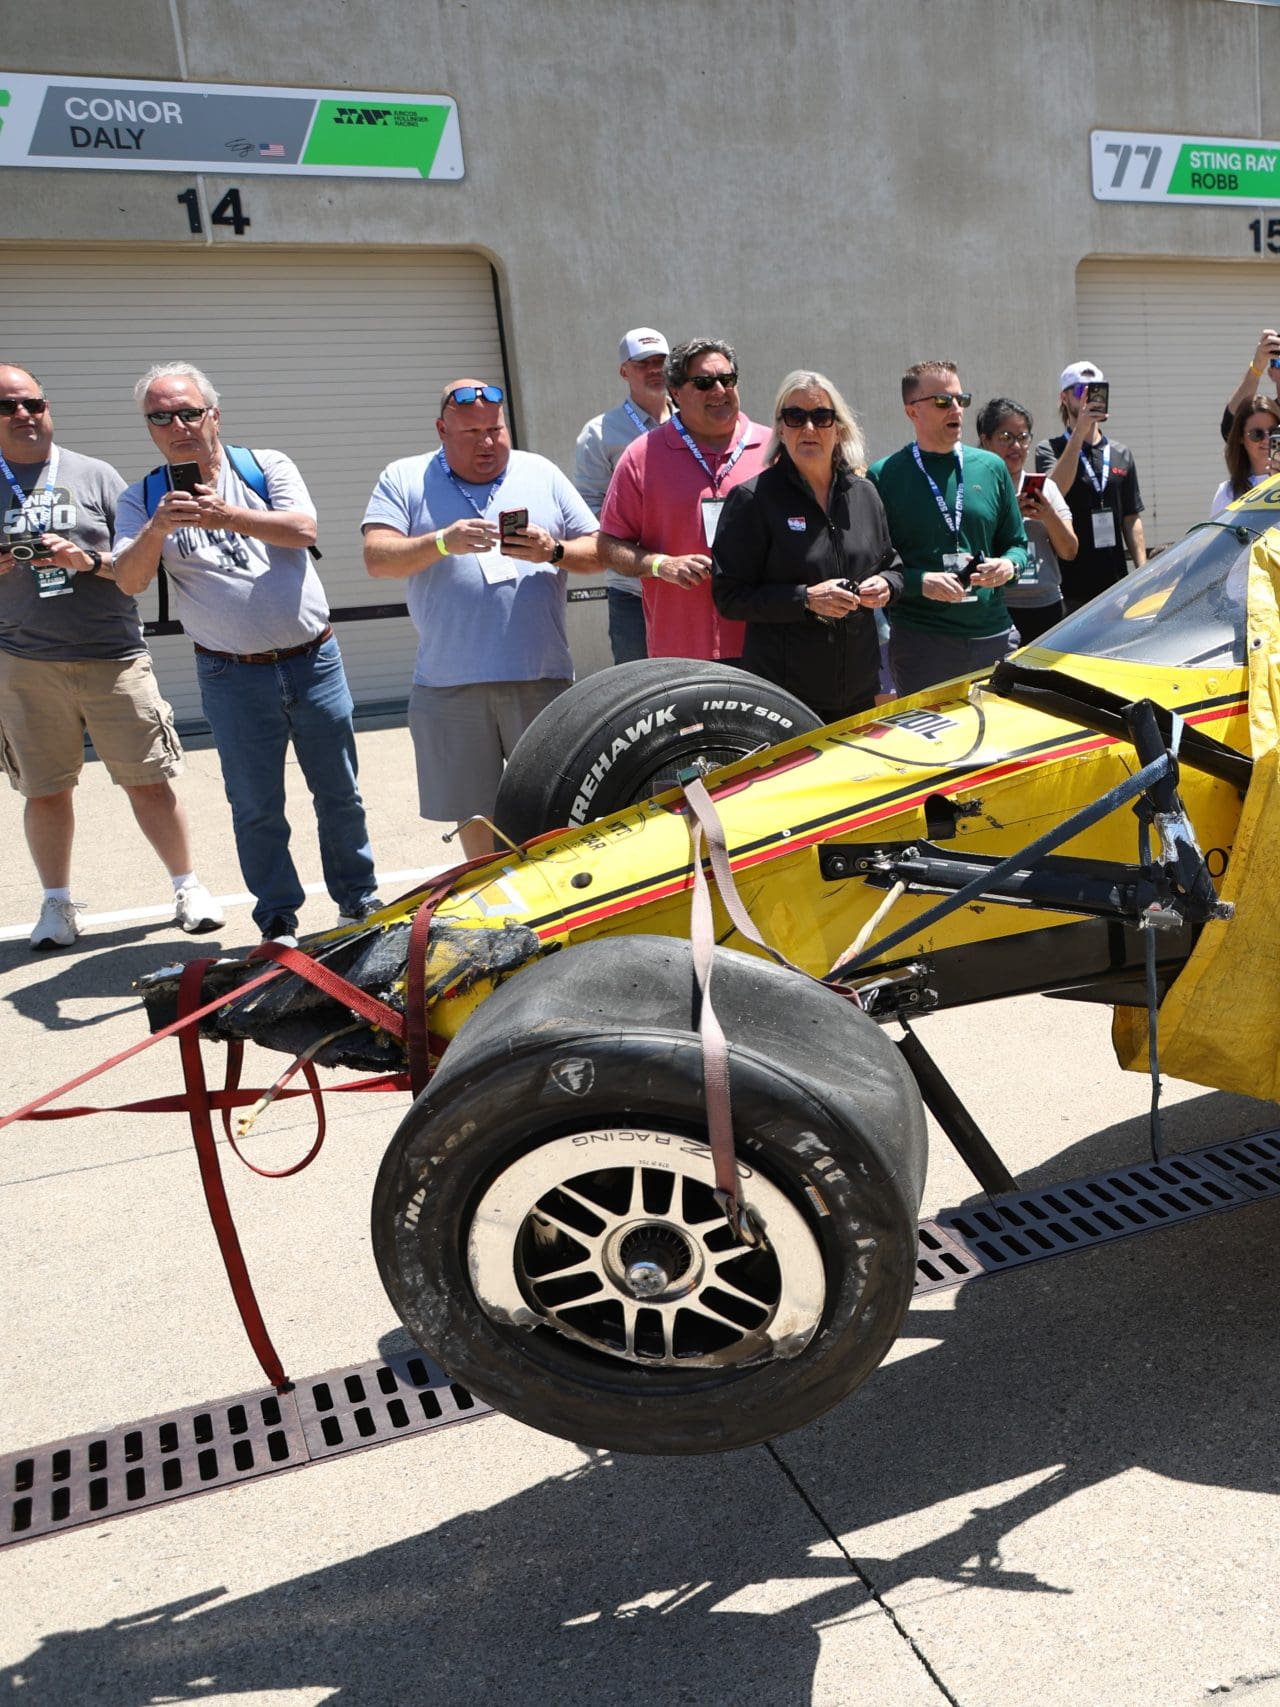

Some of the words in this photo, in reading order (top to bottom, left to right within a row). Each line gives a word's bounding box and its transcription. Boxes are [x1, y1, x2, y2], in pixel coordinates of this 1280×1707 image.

[65, 97, 183, 124] CONOR
[69, 126, 145, 150] DALY
[1104, 144, 1163, 189] 77
[1190, 151, 1243, 171] STING
[1246, 153, 1278, 172] RAY
[1191, 173, 1239, 191] ROBB
[177, 188, 250, 235] 14
[681, 433, 703, 461] GRAND
[934, 494, 950, 513] 500
[702, 700, 754, 712] INDY
[754, 706, 793, 729] 500
[572, 1131, 671, 1147] RACING
